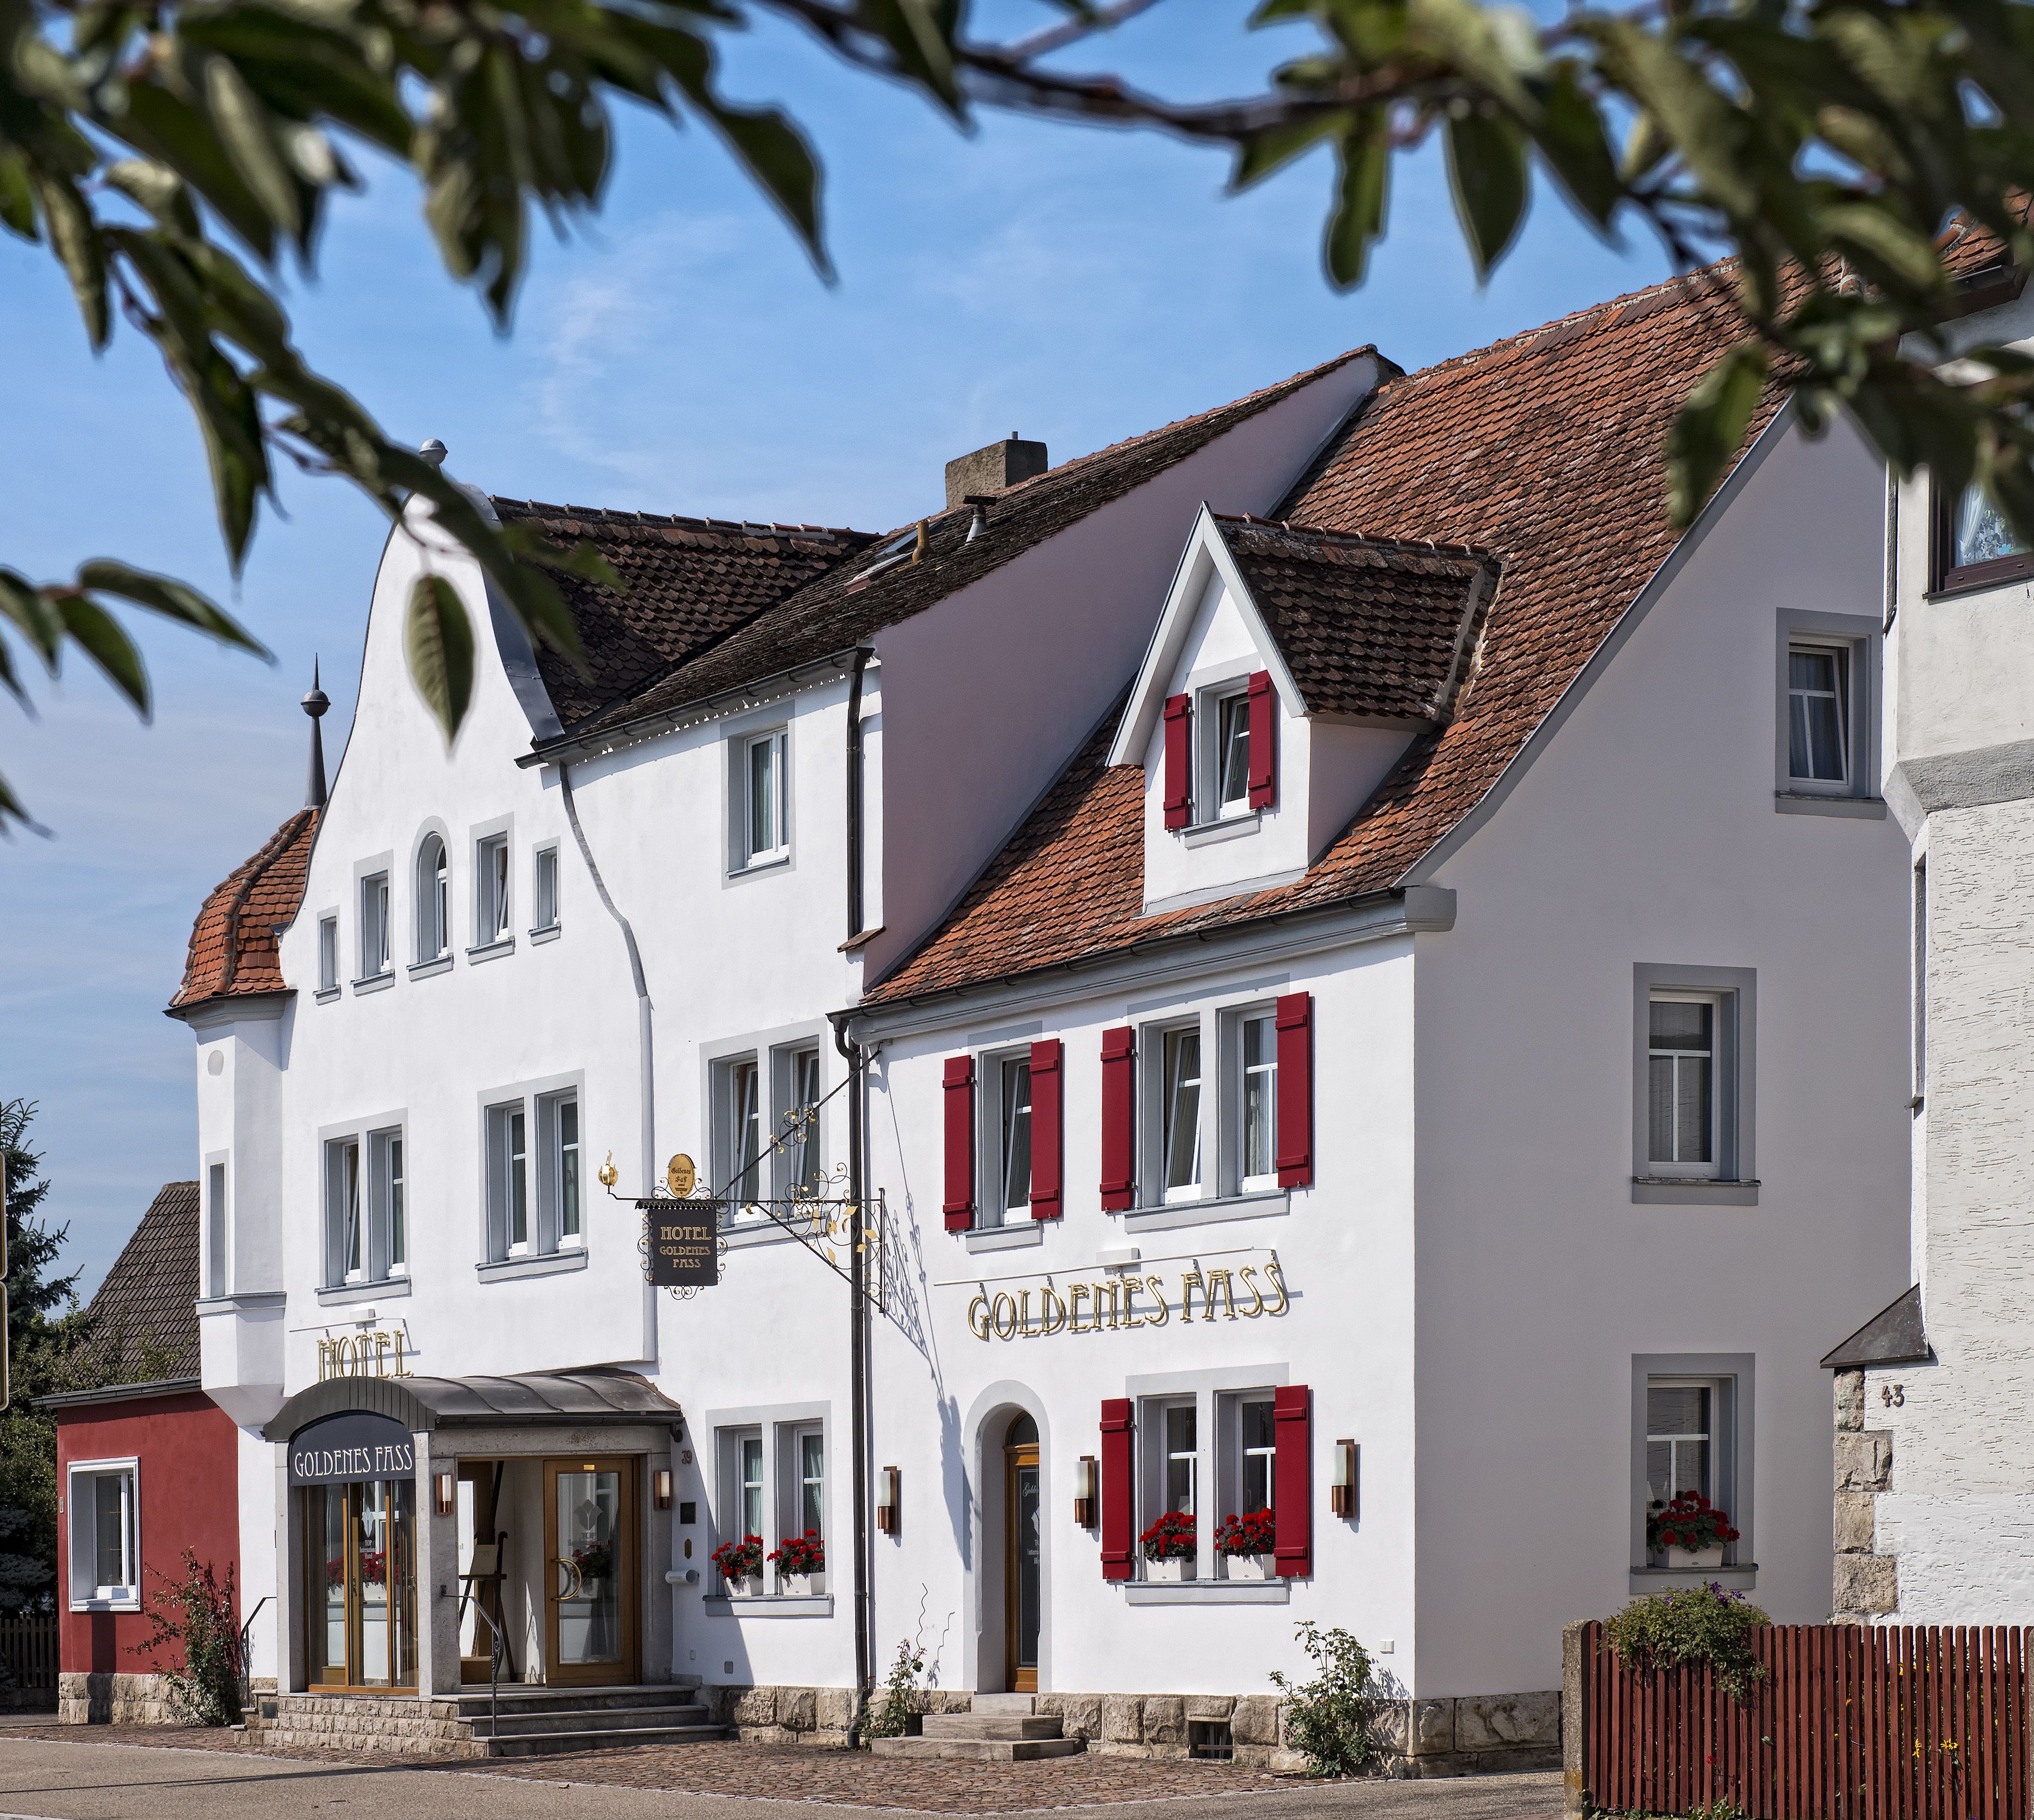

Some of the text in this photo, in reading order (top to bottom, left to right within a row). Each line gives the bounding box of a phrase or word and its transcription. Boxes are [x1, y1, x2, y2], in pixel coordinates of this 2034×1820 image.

[660, 1226, 712, 1240] HOTEL
[659, 1246, 711, 1255] GOLDENES
[673, 1259, 701, 1268] FASS
[968, 1262, 1289, 1340] GOLDENES FASS
[317, 1330, 414, 1382] HOTEL
[1881, 1384, 1905, 1407] 43
[294, 1444, 413, 1477] GOLDENES FASS
[681, 1450, 692, 1465] 39
